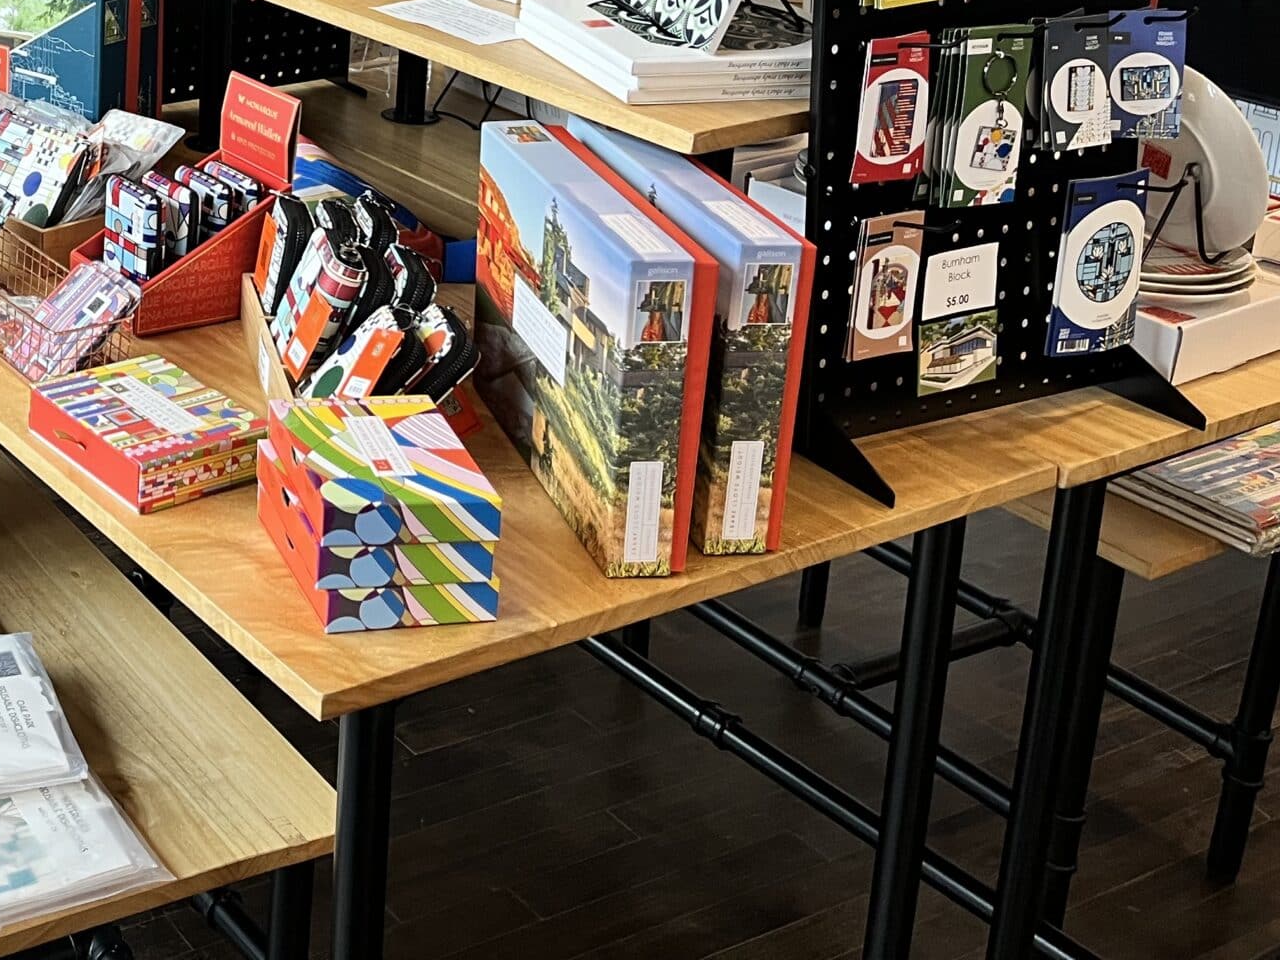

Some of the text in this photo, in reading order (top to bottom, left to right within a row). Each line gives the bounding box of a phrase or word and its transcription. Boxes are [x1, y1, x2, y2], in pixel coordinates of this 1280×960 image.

[941, 254, 980, 270] Burnham
[948, 269, 971, 283] Block
[946, 294, 970, 308] $5.00
